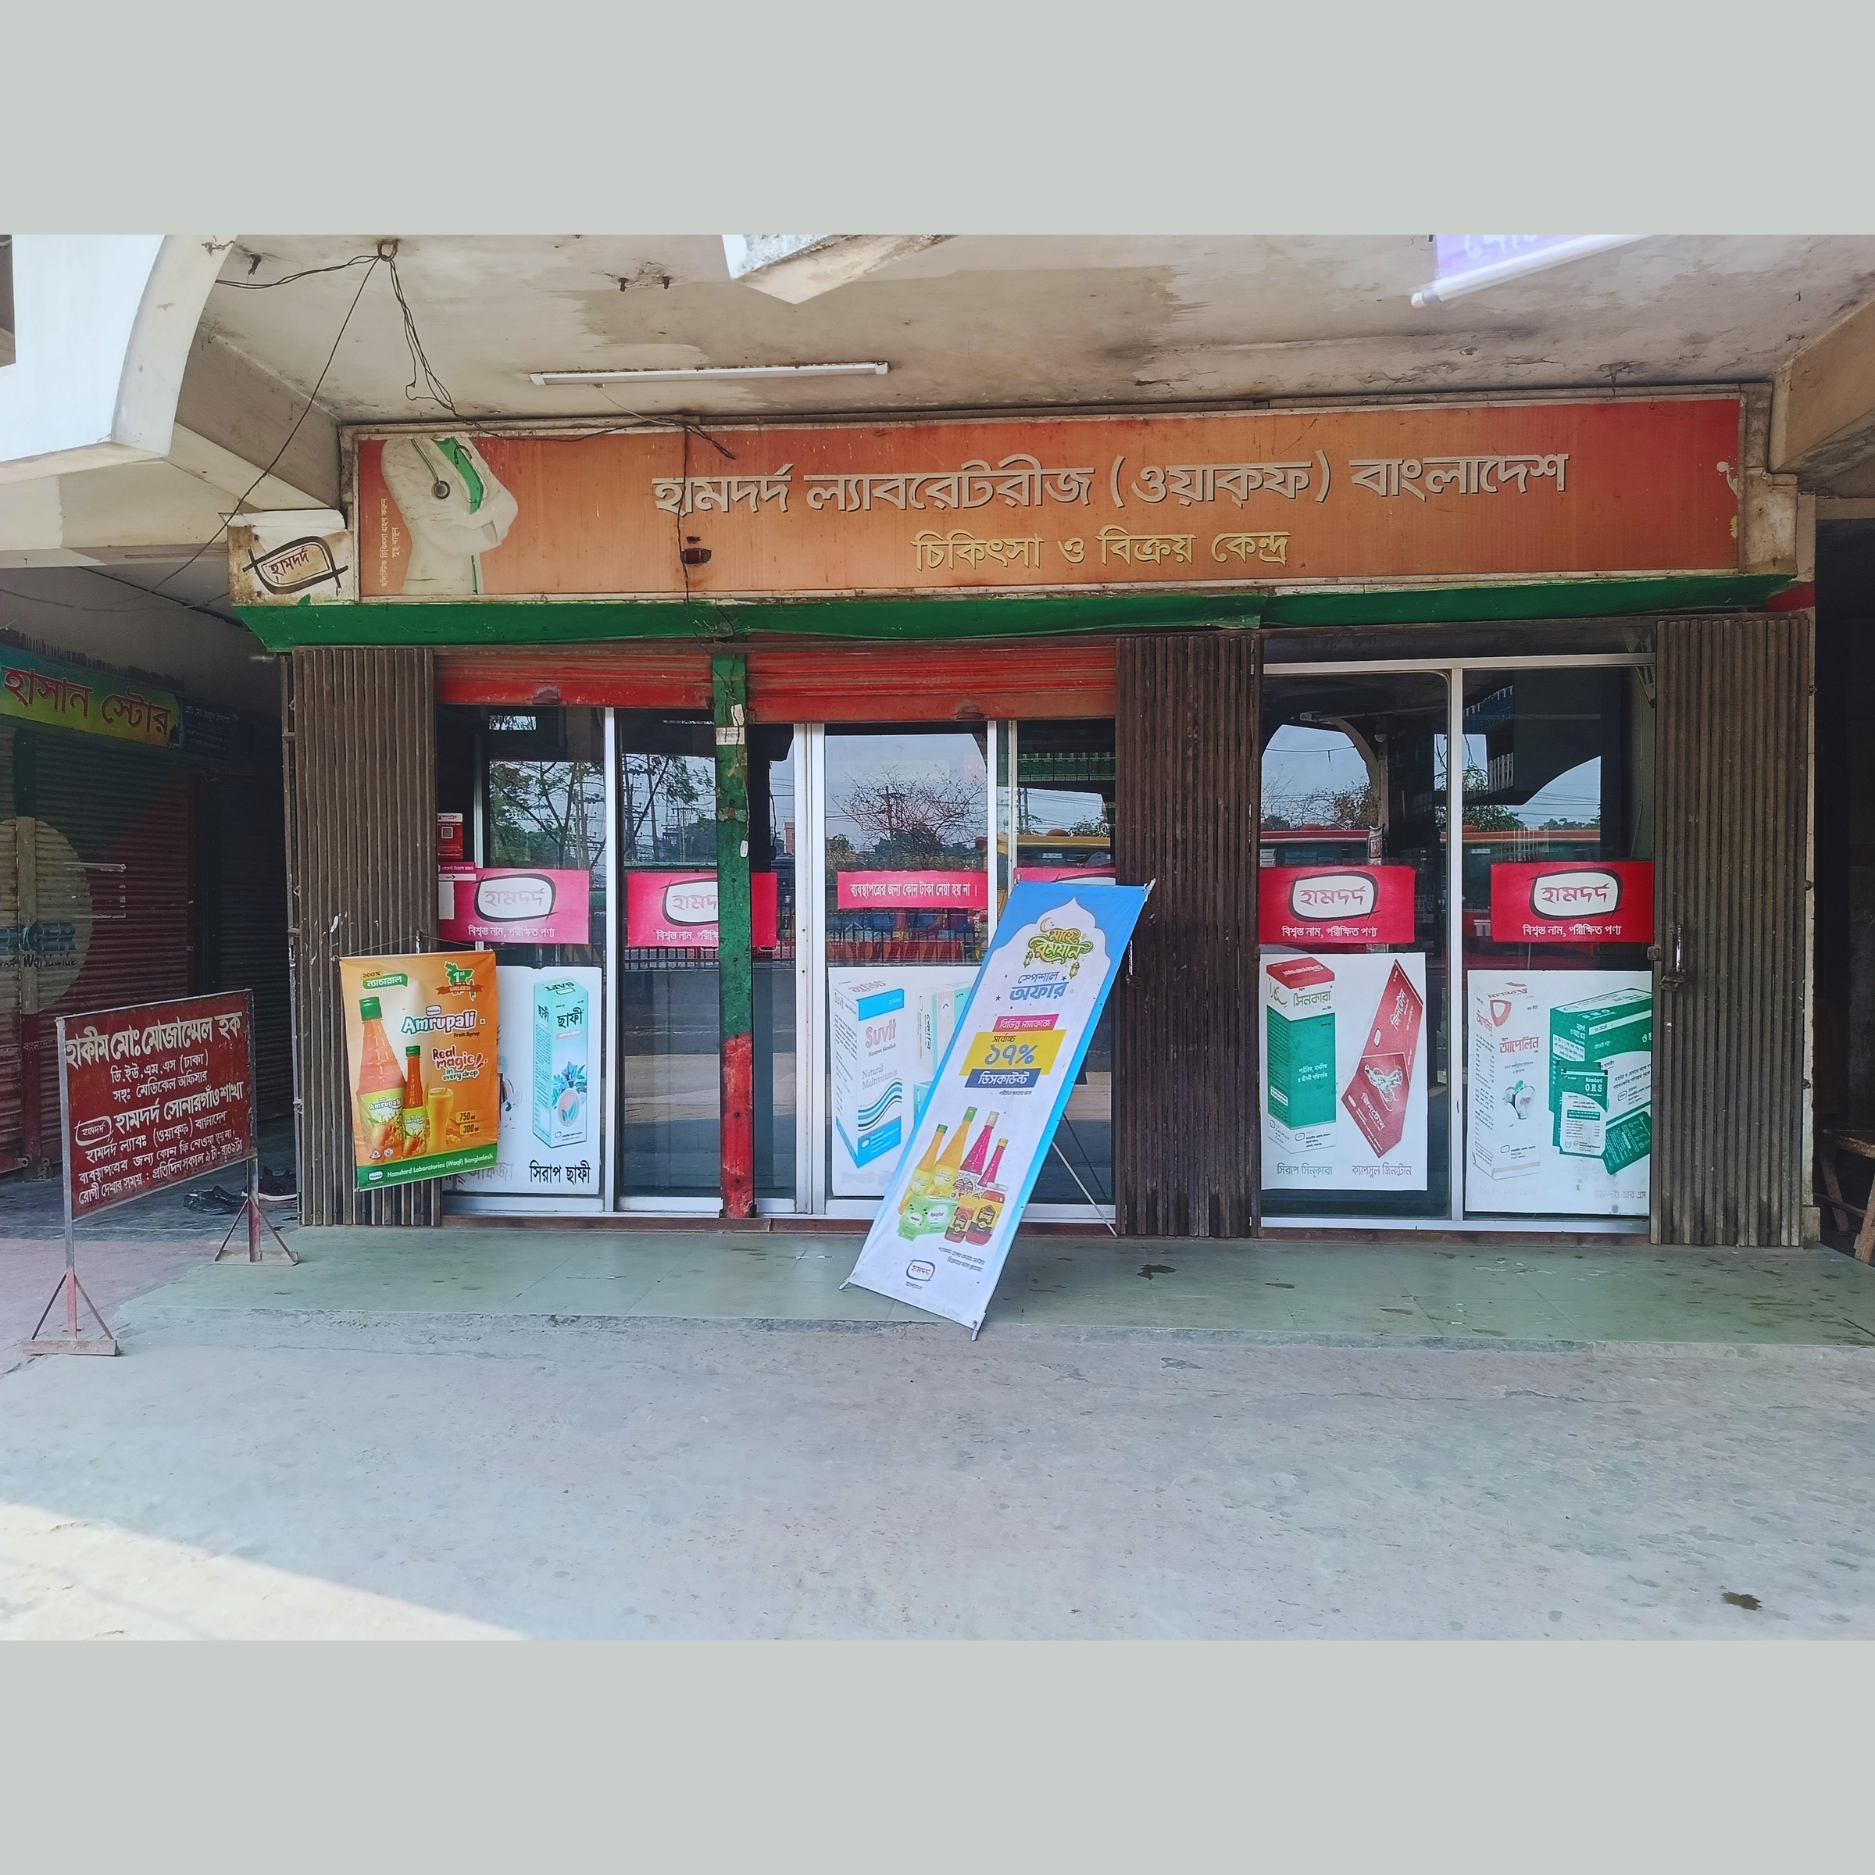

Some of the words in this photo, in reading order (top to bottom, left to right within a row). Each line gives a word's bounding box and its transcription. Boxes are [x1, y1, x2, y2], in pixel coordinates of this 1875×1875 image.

[651, 463, 795, 517] হামদর্দ
[803, 453, 1095, 512] ল্যাবরেটরীজ
[1349, 453, 1569, 503] বাংলাদেশ
[911, 528, 1044, 571] চিকিৎসা
[1058, 537, 1085, 565] ও
[1095, 524, 1197, 566] বিক্রয়
[1211, 530, 1290, 566] কেন্দ্র
[268, 547, 310, 577] হামদর্দ
[1, 666, 94, 718] হাসান
[101, 686, 172, 736] স্টোর
[483, 887, 545, 907] হামদর্দ
[919, 880, 935, 897] টাকা
[1299, 885, 1366, 907] হামদর্দ
[1541, 883, 1610, 904] হামদর্দ
[672, 894, 718, 912] হামদ
[1281, 925, 1304, 939] বিশ্বস্ত
[1306, 927, 1324, 938] নাম,
[1326, 925, 1359, 938] পরীক্ষিত
[1361, 927, 1378, 938] পণ্য
[1522, 924, 1546, 938] বিশ্বস্ত
[1547, 926, 1567, 938] নাম,
[1568, 924, 1603, 936] পরীক্ষিত
[1604, 926, 1622, 936] পণ্য
[1018, 971, 1060, 984] স্পেশাল
[1009, 981, 1070, 1001] অফার
[401, 1010, 477, 1034] Amrupali
[557, 1006, 583, 1029] ছাফী
[110, 1024, 141, 1060] মোঃ
[142, 1015, 213, 1055] মোজাম্মেল
[214, 1011, 243, 1041] হক
[1499, 1036, 1539, 1054] আপেলিন
[180, 1048, 209, 1074] (ঢাকা)
[432, 1045, 456, 1060] Real
[984, 1044, 1038, 1066] ১৭%
[462, 1069, 479, 1077] drop
[978, 1070, 1030, 1085] ডিসকাউন্ট
[136, 1076, 176, 1099] মেডিকেল
[177, 1069, 208, 1087] অফিসার
[1584, 1083, 1603, 1092] ORS
[113, 1097, 160, 1134] হামদর্দ
[164, 1084, 220, 1120] সোনারগাঁও
[219, 1081, 244, 1103] শাখা
[459, 1112, 470, 1121] 750
[82, 1121, 106, 1136] হামদর্দ
[85, 1137, 118, 1164] হামদর্দ
[194, 1110, 228, 1130] বাংলাদেশ
[463, 1124, 474, 1134] 300
[132, 1152, 154, 1167] জন্য
[156, 1146, 178, 1161] কোন
[387, 1167, 412, 1178] Hamdard
[413, 1162, 446, 1173] Laboratories
[446, 1158, 464, 1169] (Waqf)
[464, 1153, 493, 1164] Bangladesh
[78, 1181, 100, 1205] রোগী
[101, 1179, 122, 1197] দেখার
[152, 1158, 182, 1180] প্রতিদিন
[182, 1152, 204, 1170] সকাল
[529, 1159, 562, 1184] সিরাপ
[565, 1159, 591, 1185] ছাফী
[1276, 1162, 1299, 1175] সিরাপ
[1351, 1163, 1380, 1179] ক্যাপসুল
